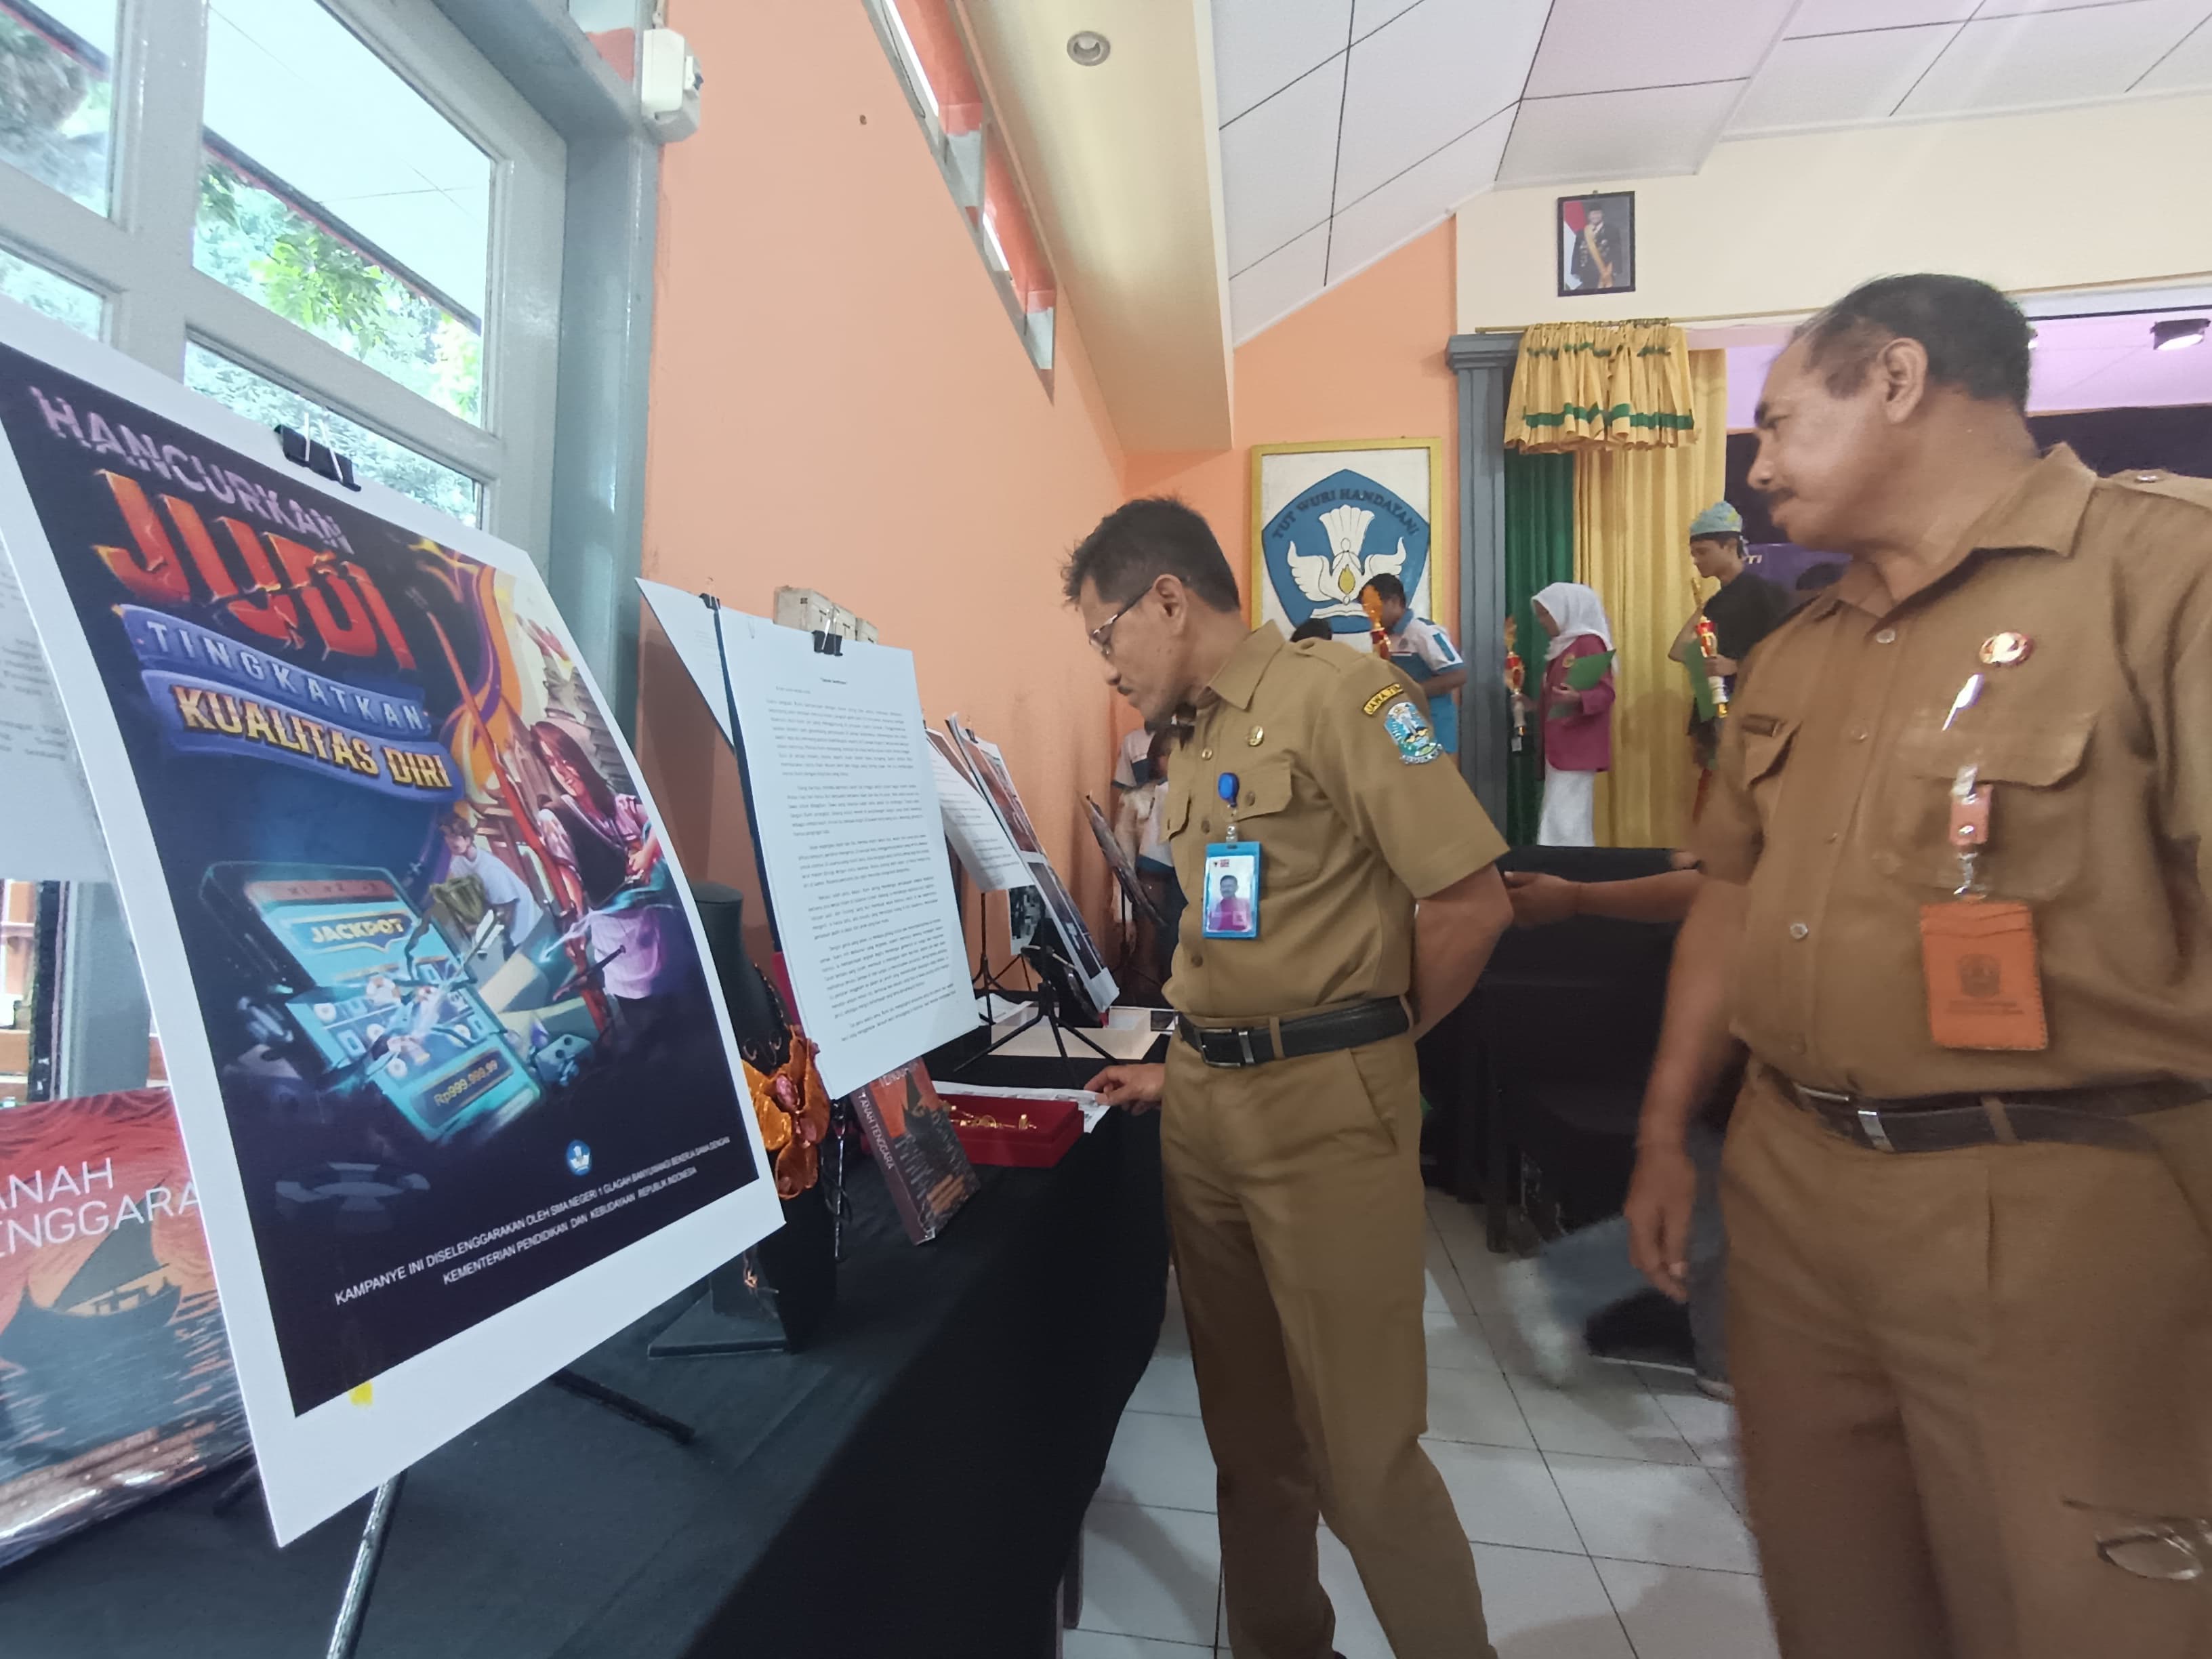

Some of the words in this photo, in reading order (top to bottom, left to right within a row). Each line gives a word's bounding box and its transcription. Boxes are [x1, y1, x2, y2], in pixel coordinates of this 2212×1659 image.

[28, 386, 353, 555] HANCURKAN
[1272, 511, 1297, 539] TUT
[1296, 489, 1336, 512] WURI
[1340, 488, 1420, 535] HANDAYANI
[91, 468, 417, 671] JUDI
[147, 620, 425, 731] TINGKATKAN
[169, 684, 379, 776] KUALITAS
[384, 750, 453, 789] DIRI
[310, 918, 404, 943] JACKPOT
[858, 1092, 874, 1125] TANAH
[871, 1122, 895, 1170] TENGGARA
[334, 1265, 407, 1305] KAMPANYE
[408, 1259, 424, 1275] INI
[426, 1217, 526, 1269] DISELENGGARAKAN
[526, 1208, 550, 1226] OLEH
[550, 1201, 569, 1216] SMA
[569, 1189, 598, 1208] NEGERI
[598, 1187, 604, 1196] 1
[603, 1176, 632, 1194] GLAGAH
[443, 1244, 516, 1285] KEMENTERIAN
[516, 1221, 569, 1252] PENDIDIKAN
[570, 1214, 588, 1229] DAN
[590, 1193, 636, 1219] KEBUDAYAAN
[638, 1179, 666, 1198] REPUBLIK
